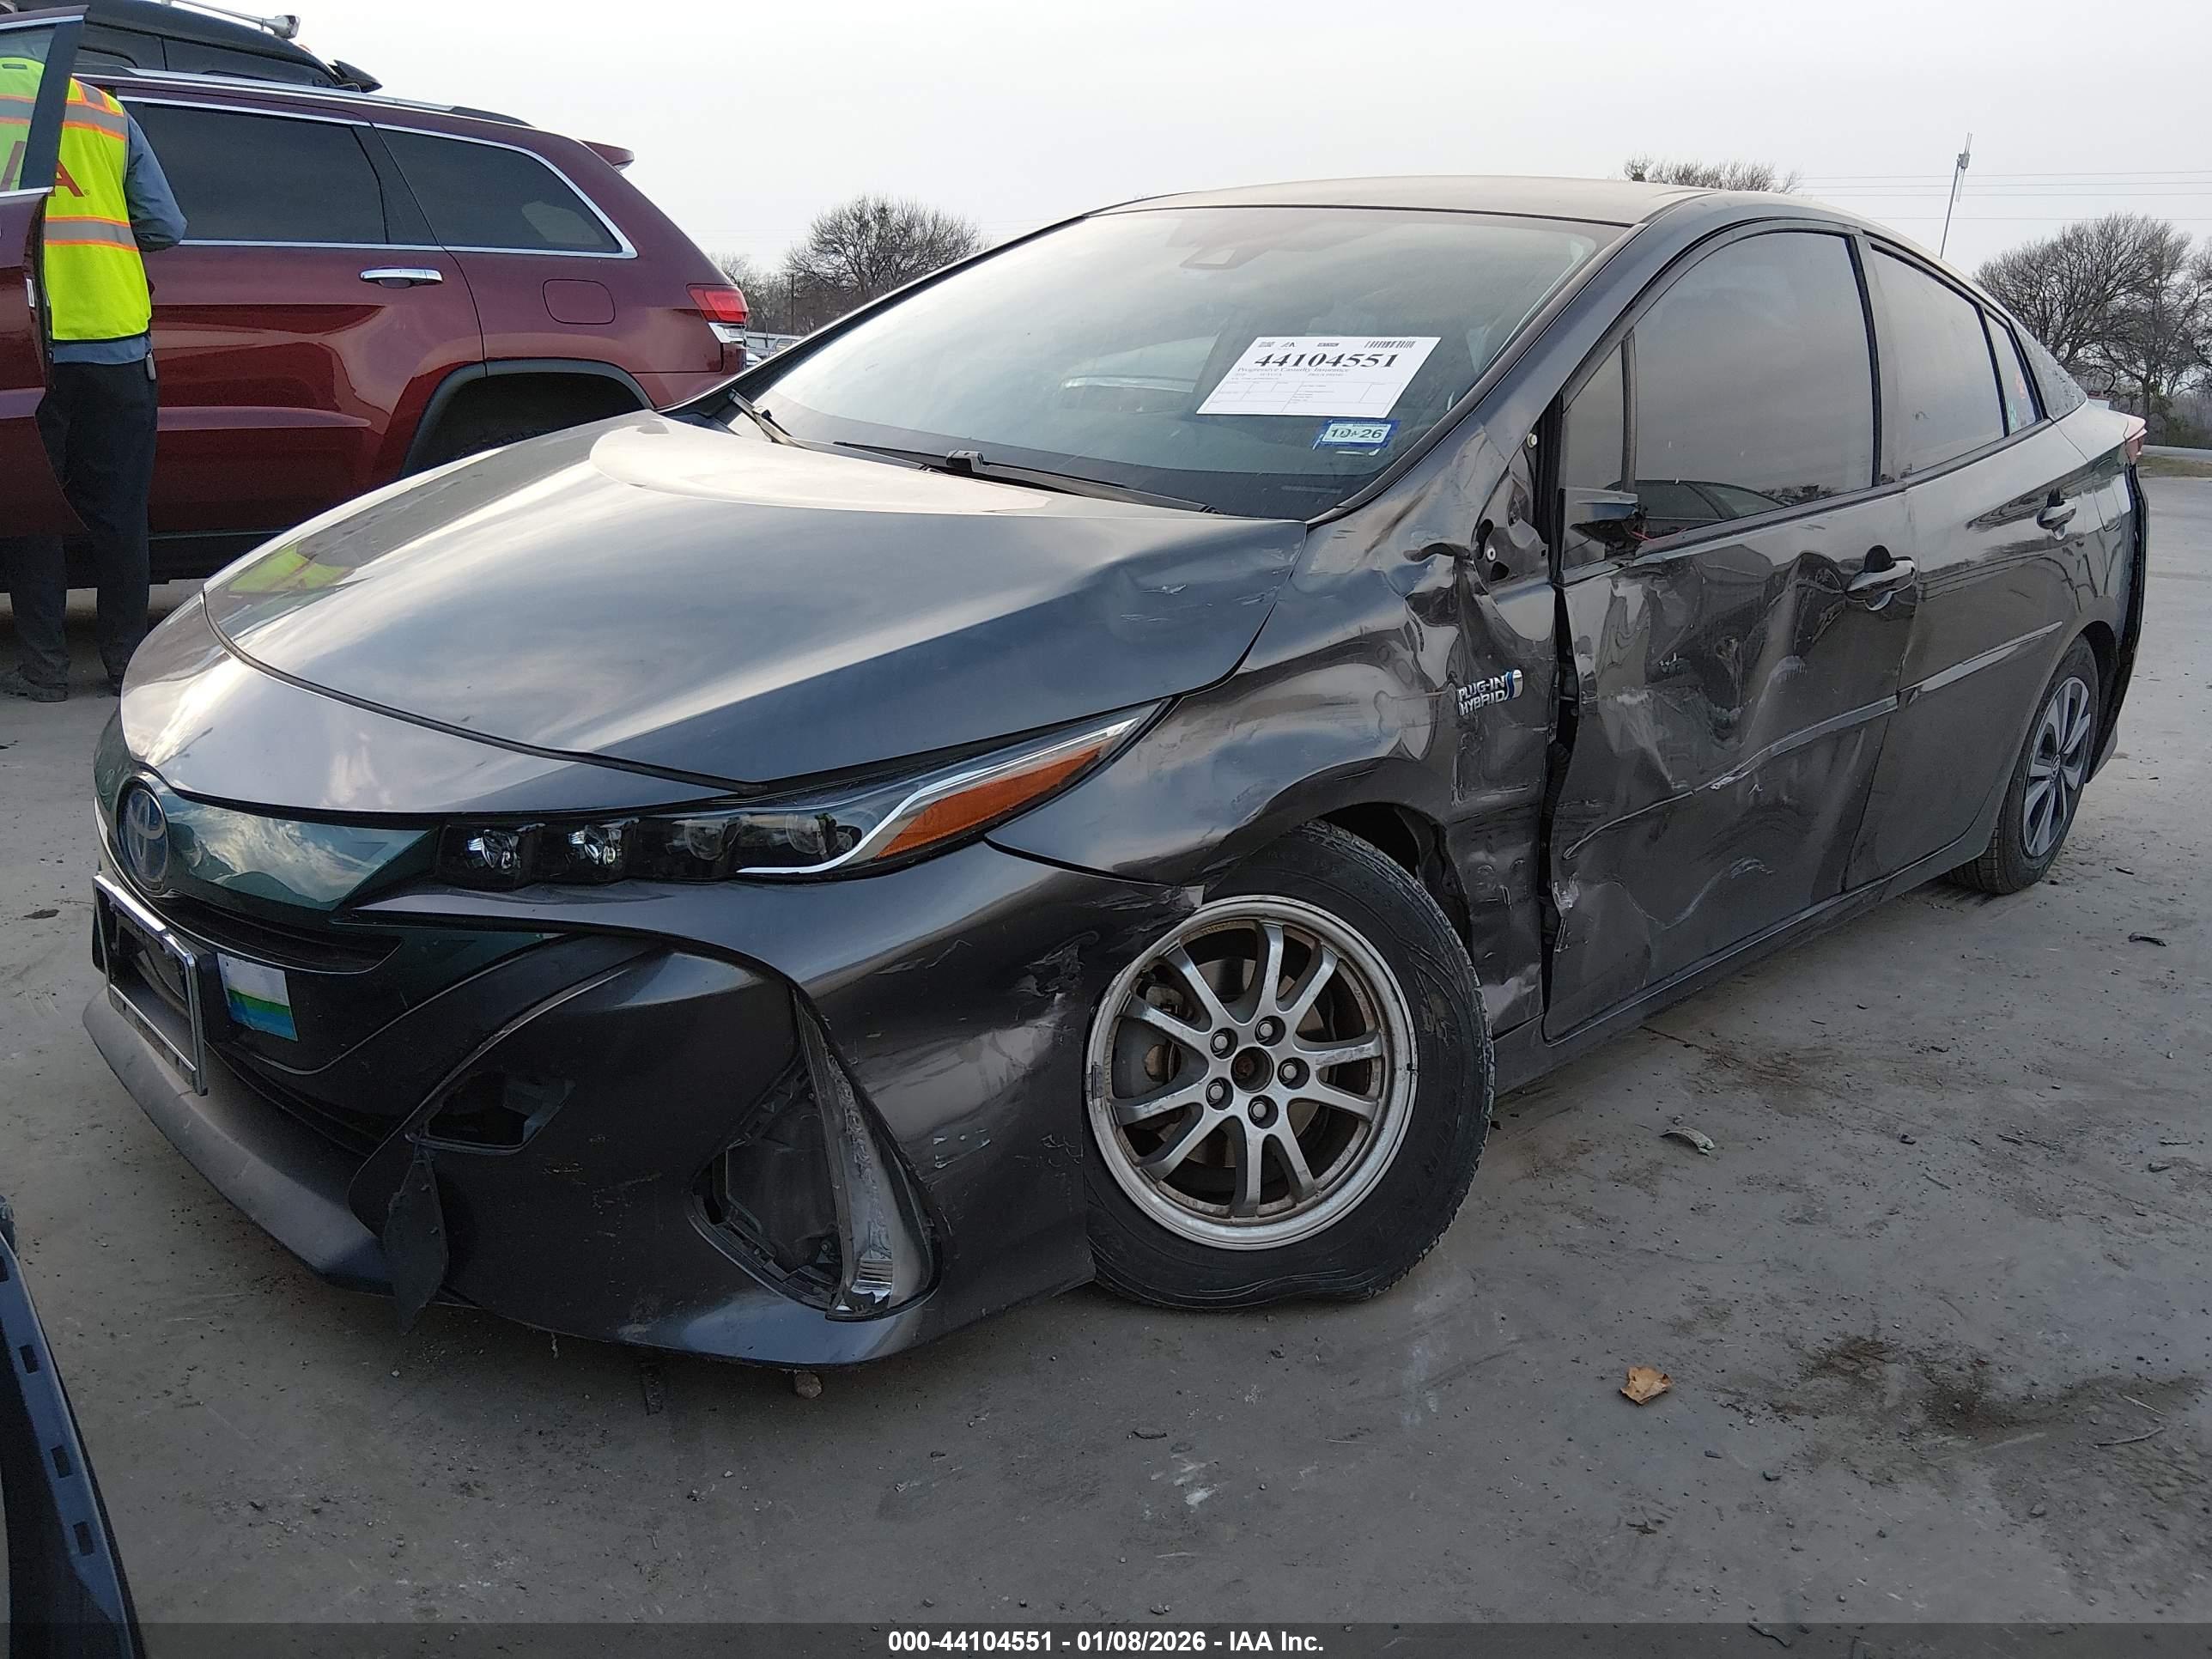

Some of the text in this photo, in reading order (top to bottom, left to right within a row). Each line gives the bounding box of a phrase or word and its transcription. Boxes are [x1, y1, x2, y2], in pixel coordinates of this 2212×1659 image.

[1255, 353, 1399, 368] 44104551
[1458, 675, 1505, 702] PLUG-IN
[1459, 690, 1505, 715] HYBRID
